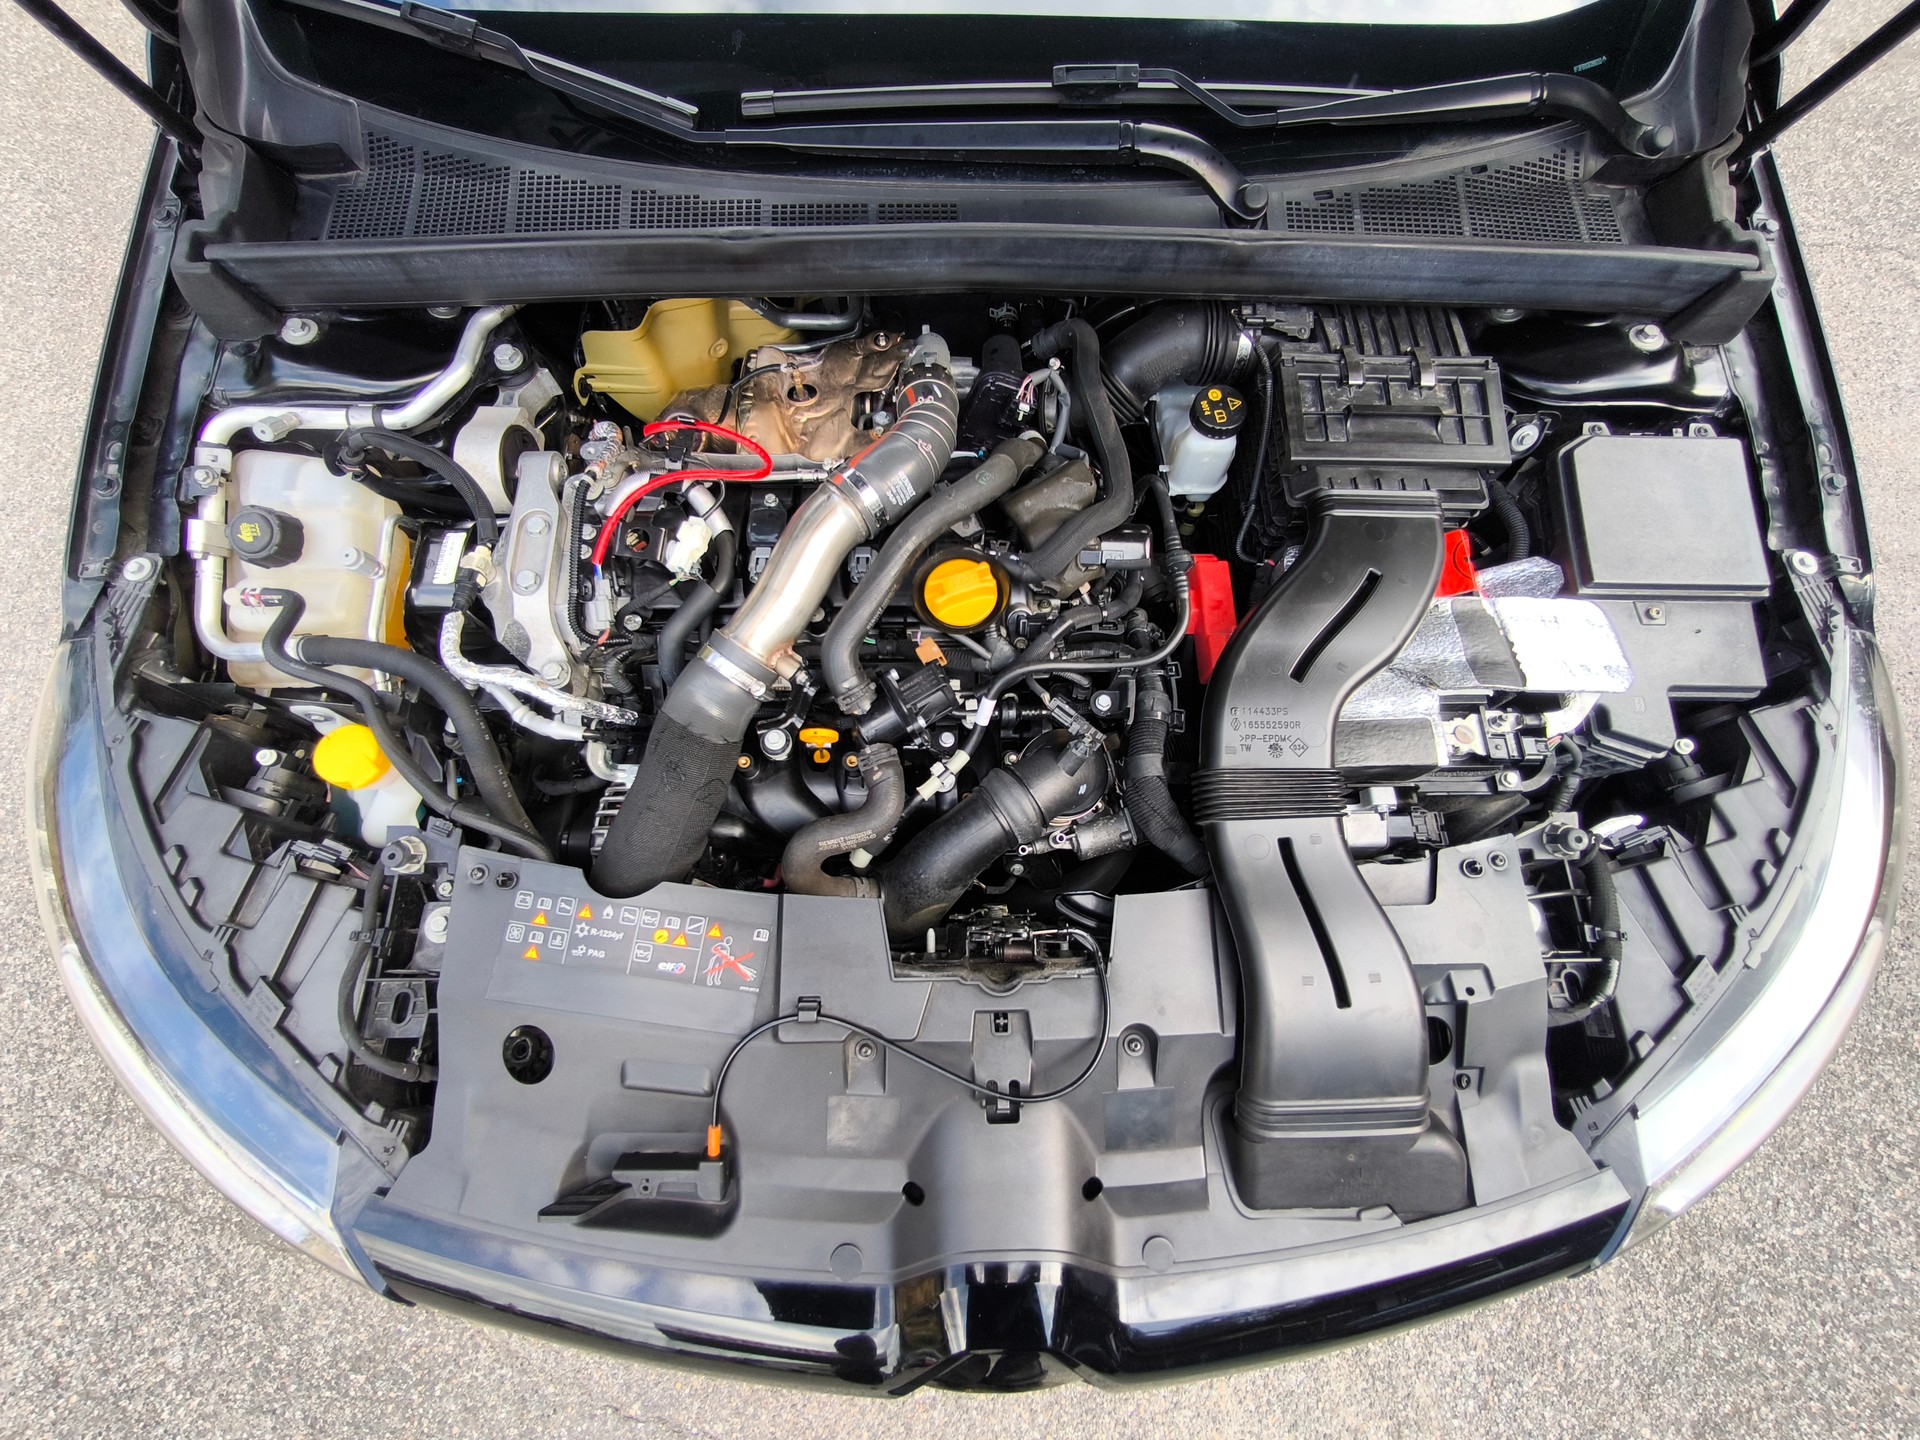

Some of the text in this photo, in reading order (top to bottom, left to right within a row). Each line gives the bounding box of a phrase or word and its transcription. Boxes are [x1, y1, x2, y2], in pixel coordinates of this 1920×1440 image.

[1242, 707, 1289, 716] 114433PS
[1243, 720, 1301, 729] 165552590R
[1240, 743, 1252, 752] TW
[587, 948, 606, 958] PAG
